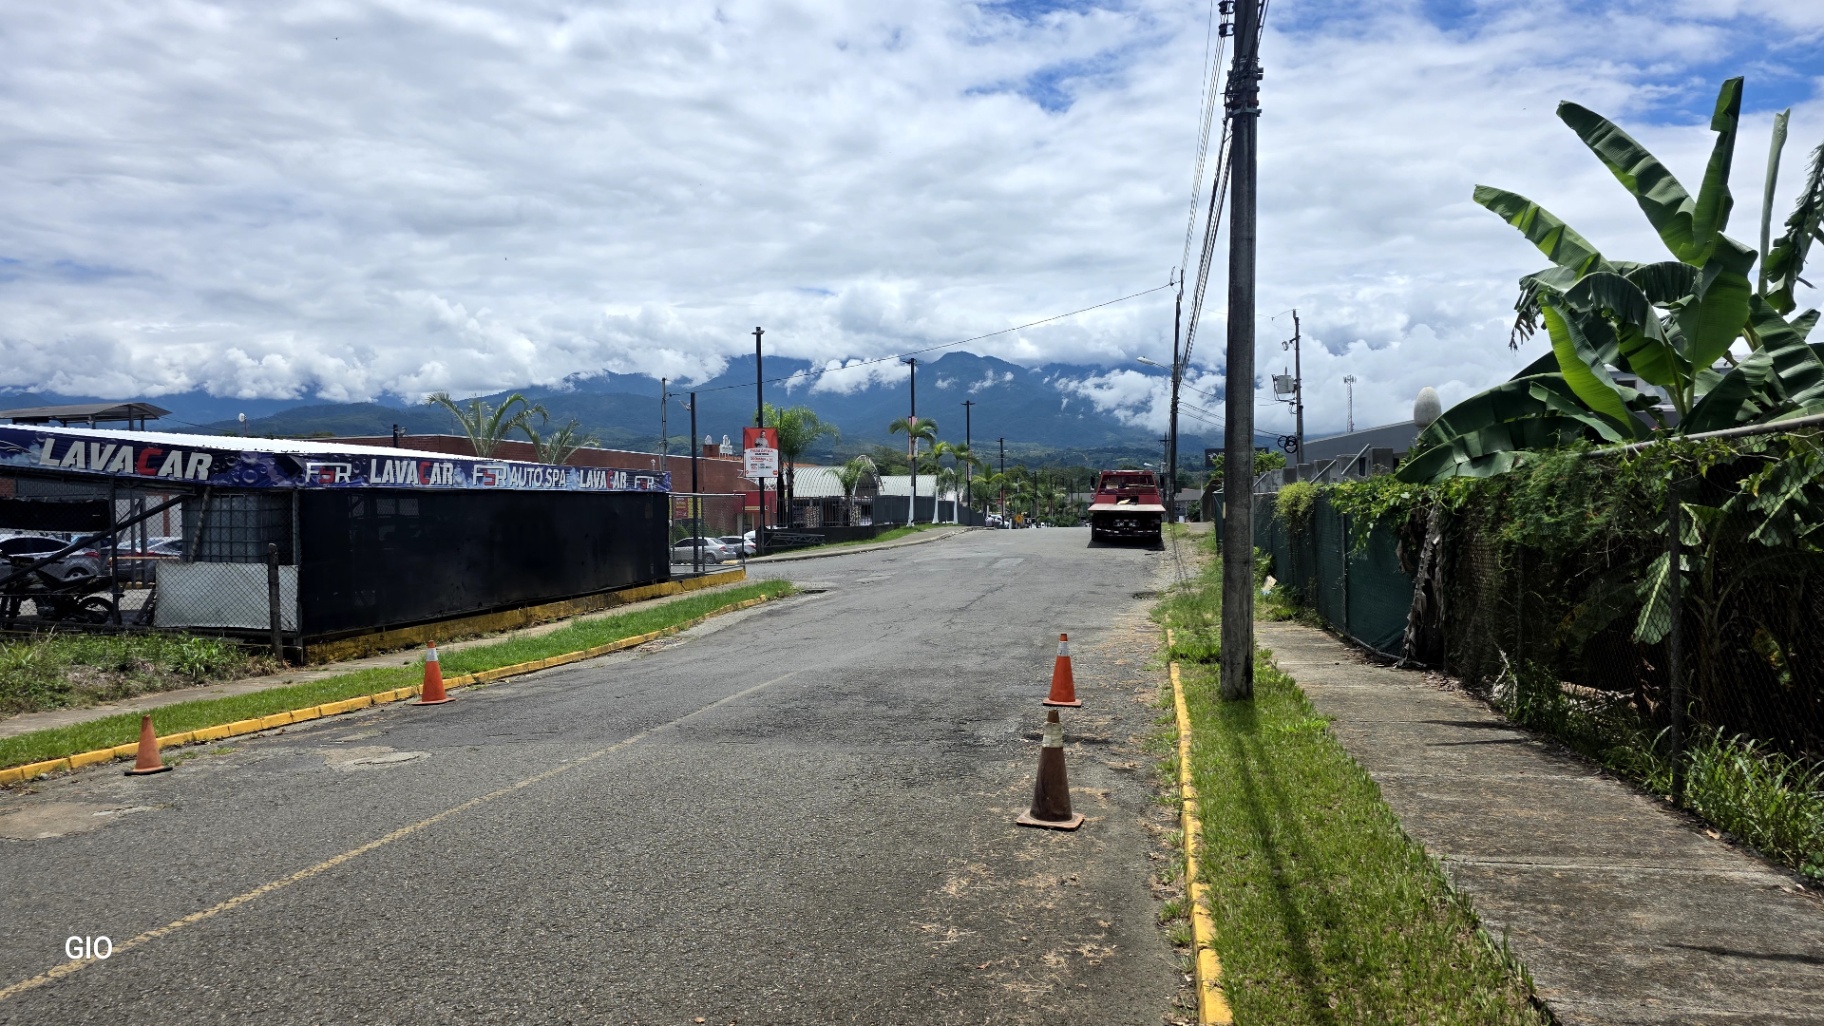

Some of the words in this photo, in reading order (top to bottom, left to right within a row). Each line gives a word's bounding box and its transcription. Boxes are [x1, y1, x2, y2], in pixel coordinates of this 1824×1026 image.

[39, 438, 213, 481] LAVACAR
[305, 462, 352, 484] FSR
[369, 458, 454, 485] LAVACAR
[472, 464, 507, 487] FSR
[510, 466, 543, 487] AUTO
[545, 468, 567, 487] SPA
[580, 469, 628, 489] LAVACAR
